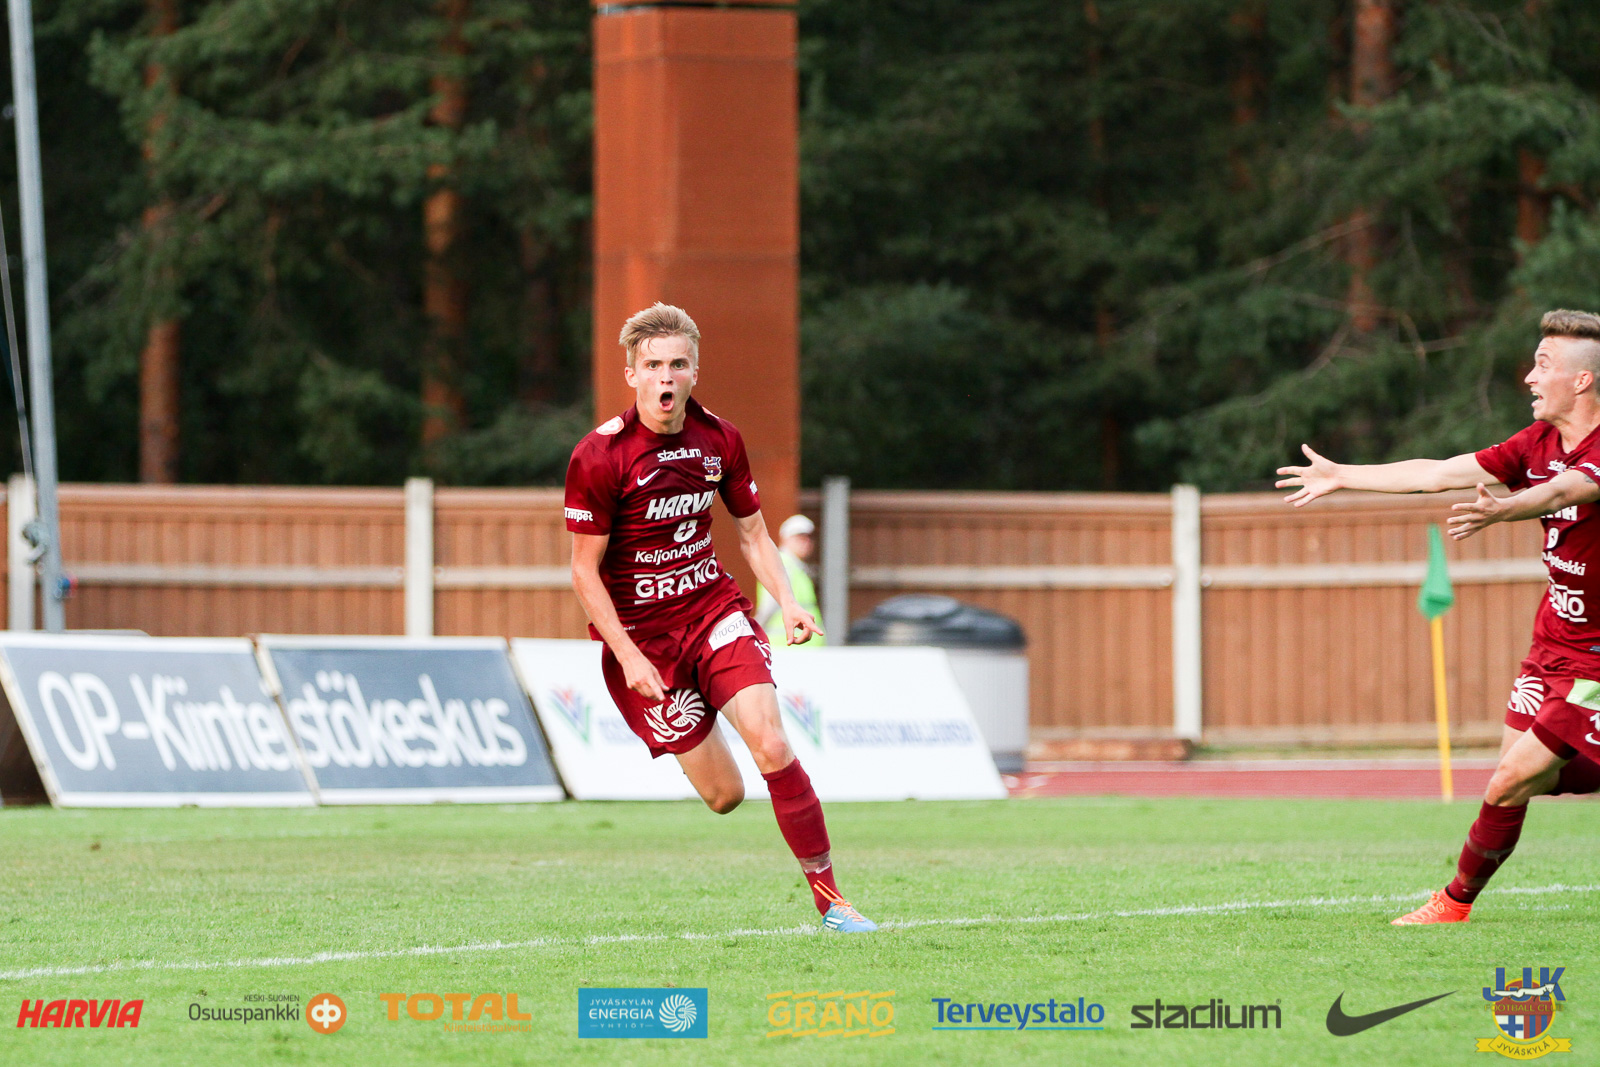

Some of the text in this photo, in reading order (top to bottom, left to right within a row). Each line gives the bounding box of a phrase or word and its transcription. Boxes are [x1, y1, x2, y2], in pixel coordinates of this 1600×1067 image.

[657, 448, 702, 462] stadium
[645, 489, 718, 520] HARVI
[636, 558, 719, 599] GRANO
